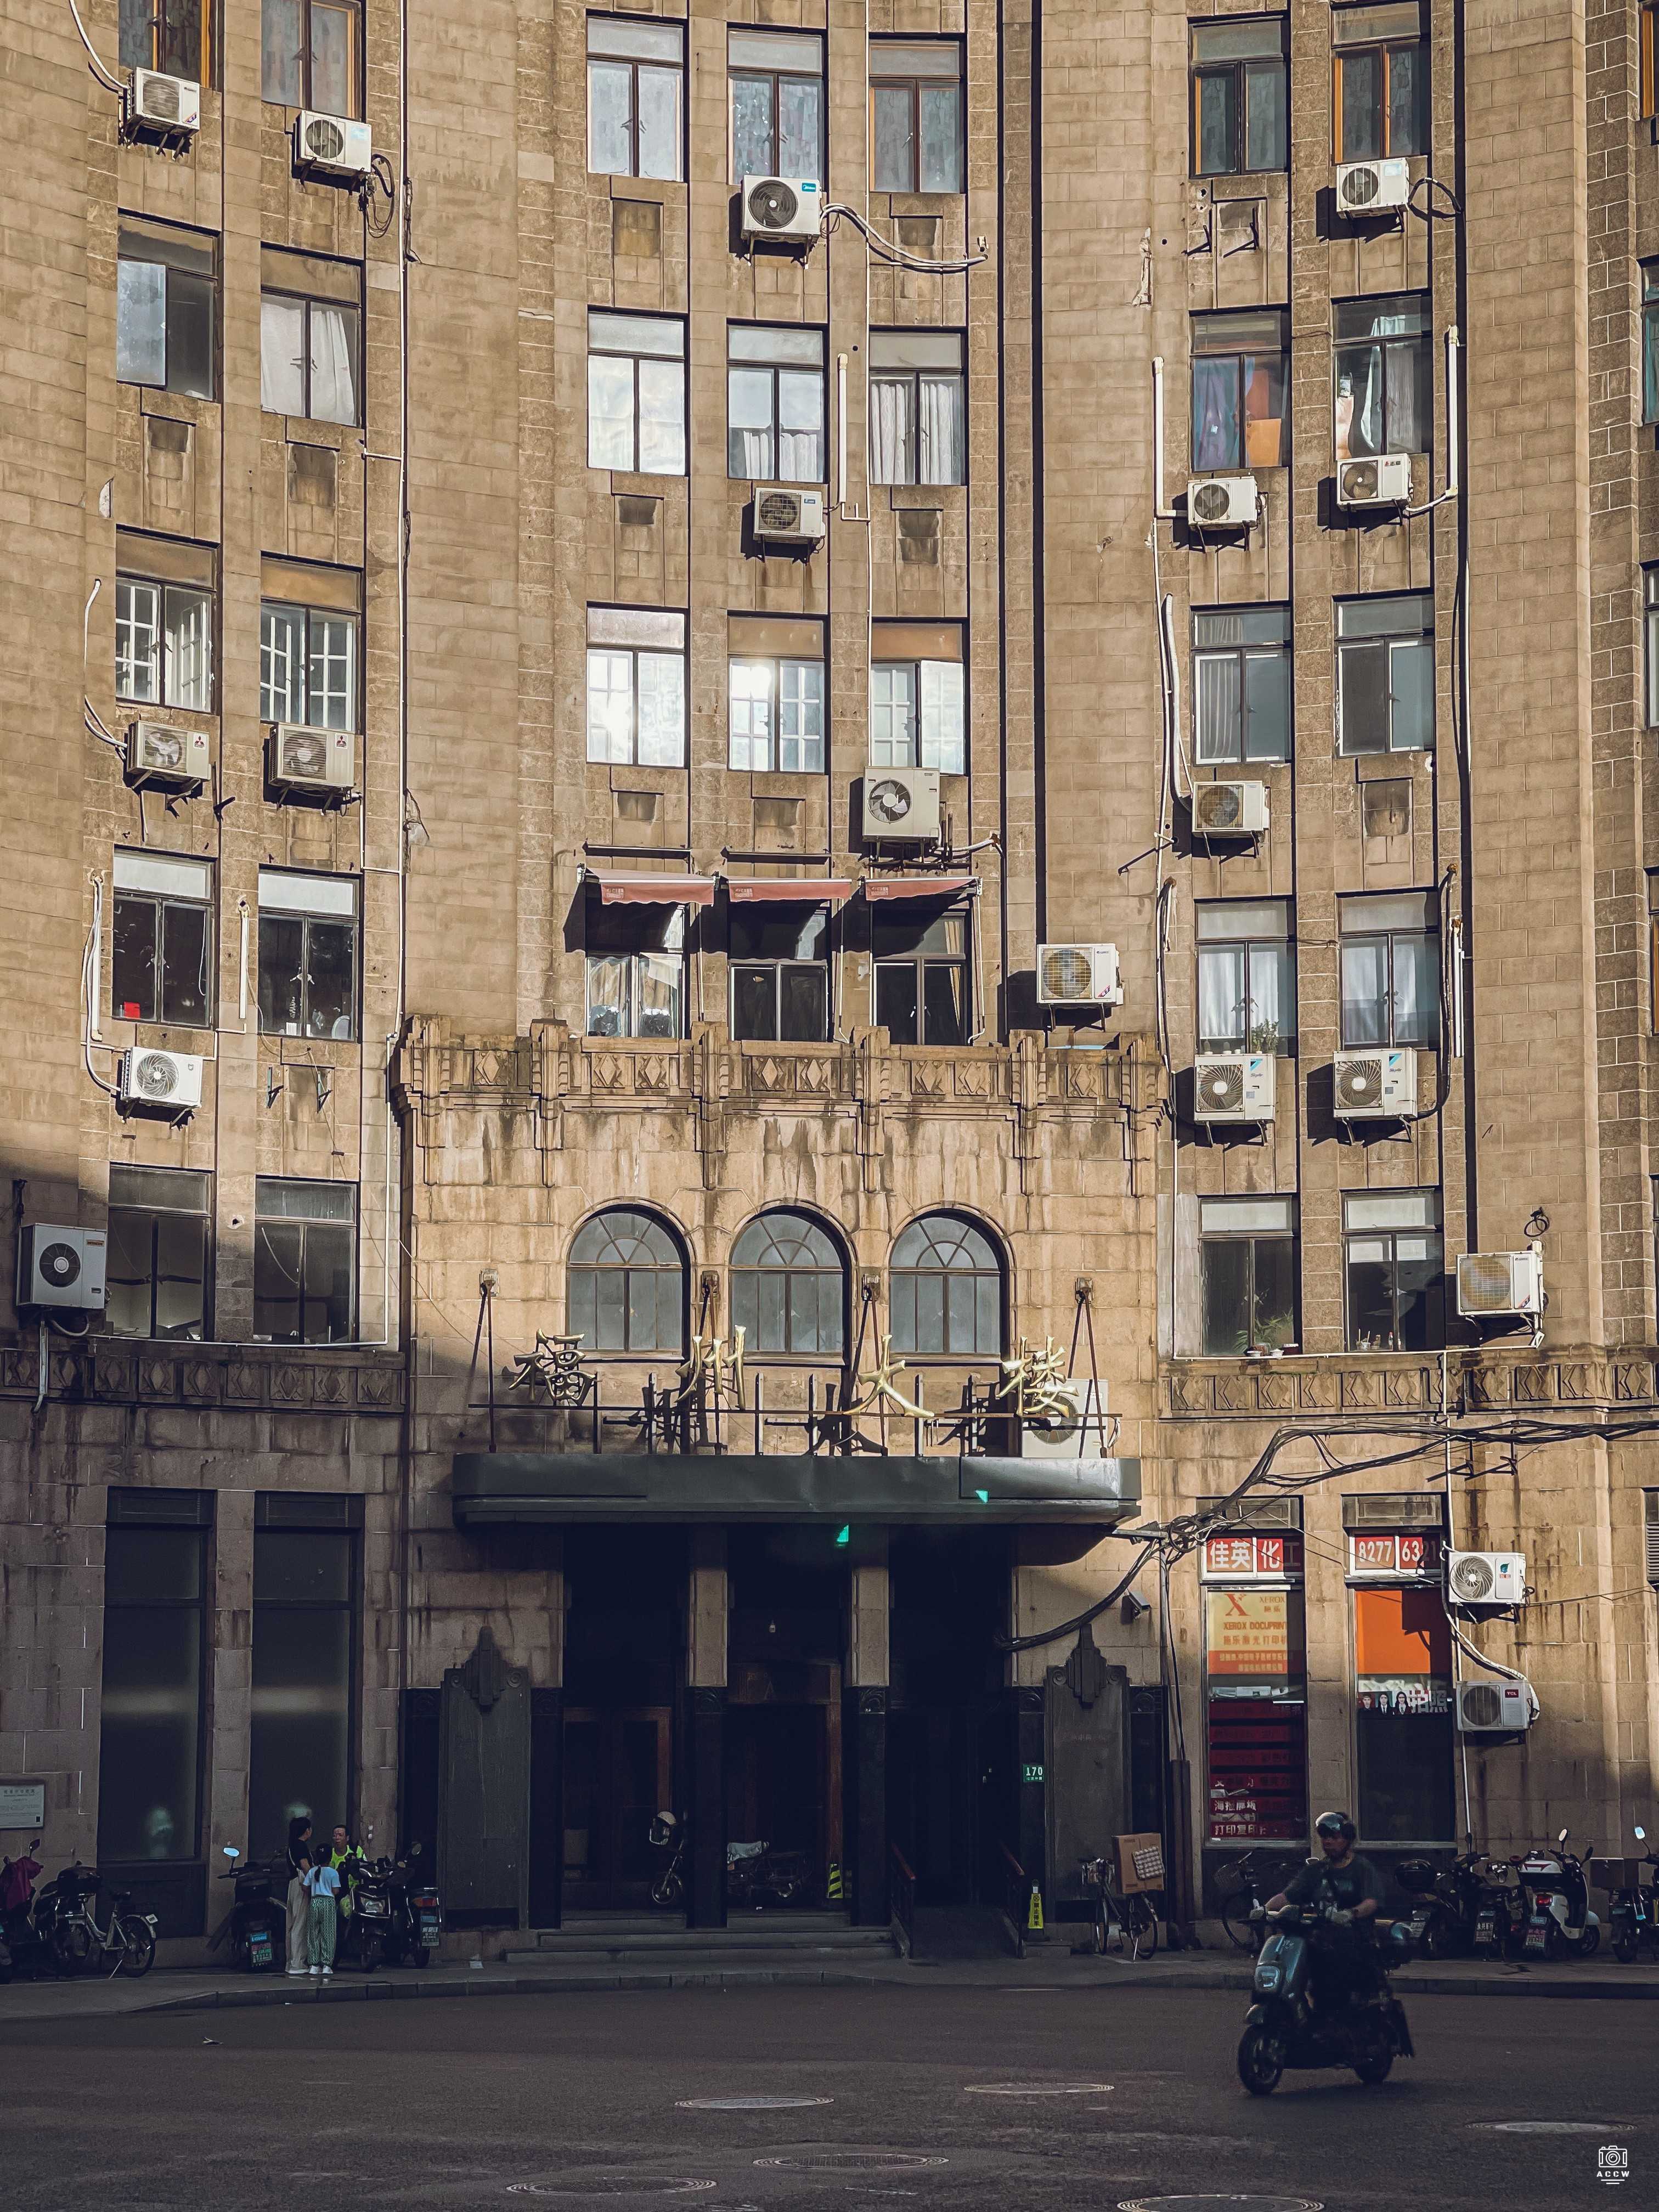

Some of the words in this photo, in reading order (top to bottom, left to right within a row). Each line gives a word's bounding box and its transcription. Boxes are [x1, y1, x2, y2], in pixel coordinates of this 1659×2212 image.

[508, 1324, 1080, 1418] 福州大楼
[1358, 1541, 1392, 1563] 8277
[1223, 1622, 1247, 1630] XEROX
[1026, 1767, 1043, 1776] 170
